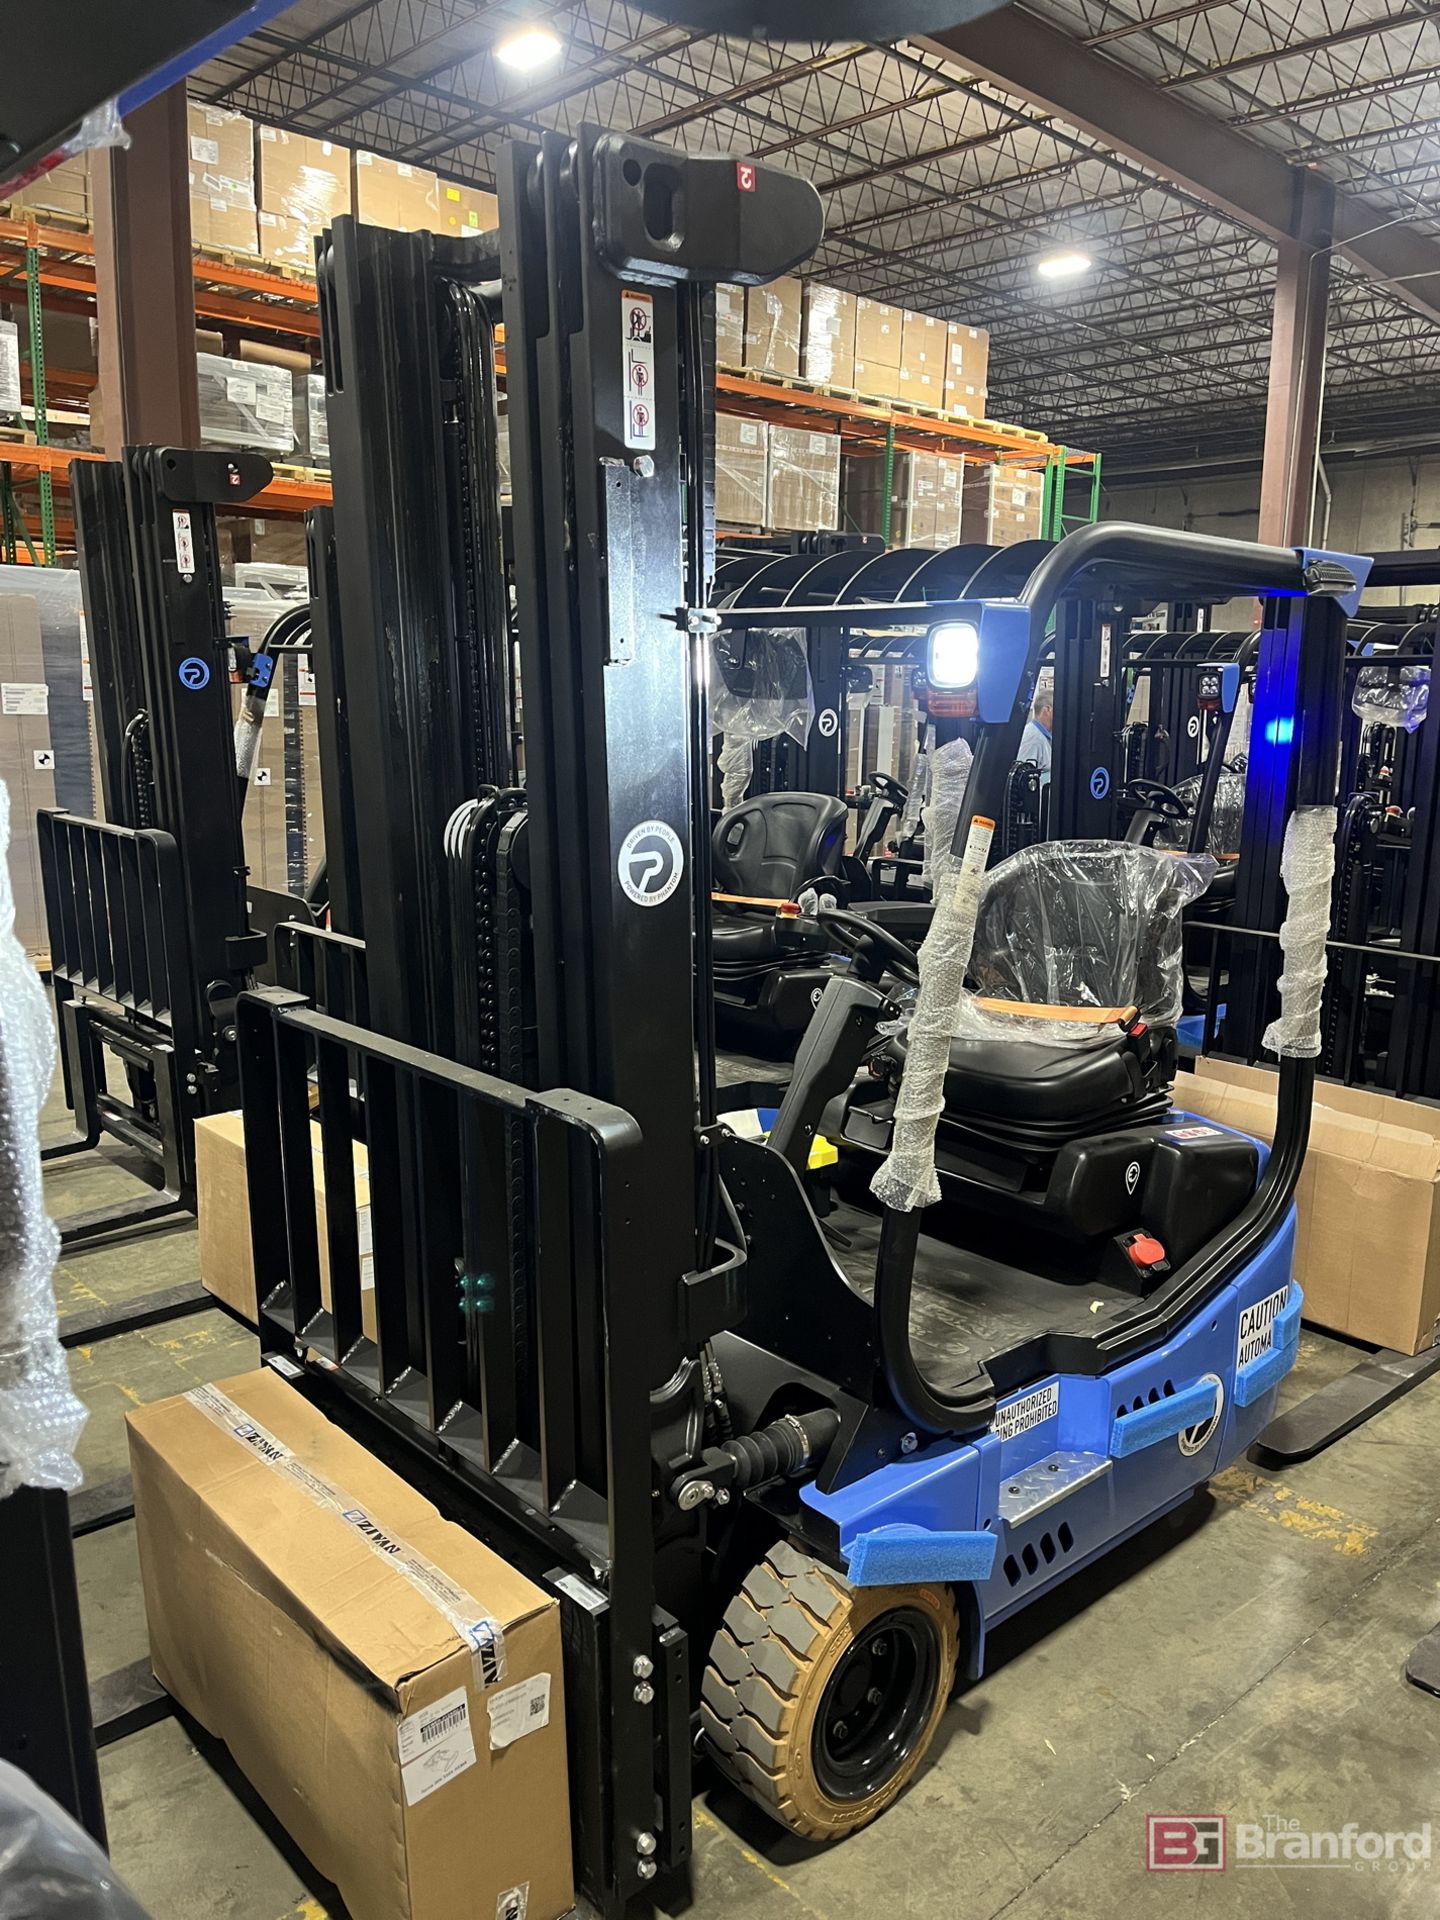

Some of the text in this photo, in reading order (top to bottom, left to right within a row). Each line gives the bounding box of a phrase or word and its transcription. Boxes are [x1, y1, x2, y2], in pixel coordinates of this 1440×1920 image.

[626, 828, 646, 849] DRIVEN
[655, 825, 675, 843] PEOPLE
[624, 880, 648, 902] POWERED
[657, 872, 679, 900] PHANTOM
[1240, 1288, 1288, 1340] CAUTION
[995, 1387, 1052, 1428] UNAUTHORIZED
[1014, 1400, 1057, 1434] PROHIBITED
[356, 1520, 402, 1554] ZIVAN
